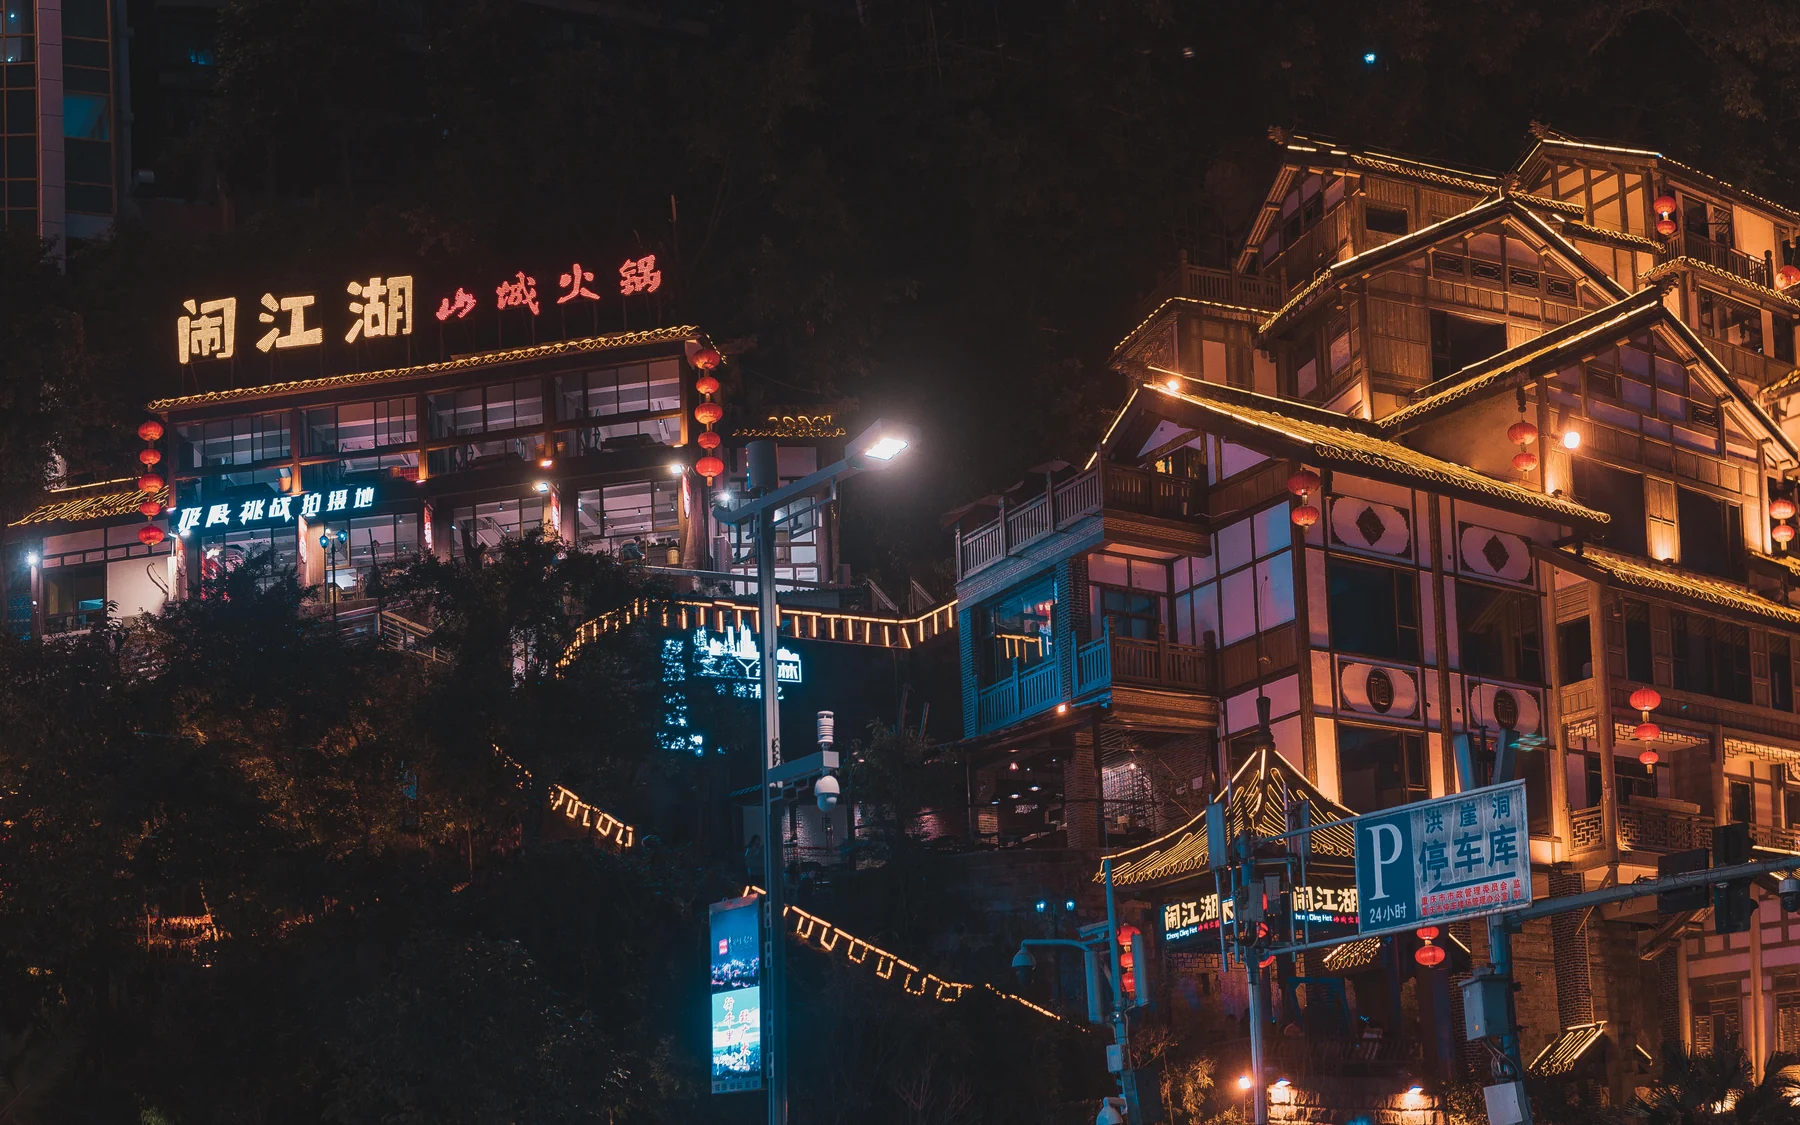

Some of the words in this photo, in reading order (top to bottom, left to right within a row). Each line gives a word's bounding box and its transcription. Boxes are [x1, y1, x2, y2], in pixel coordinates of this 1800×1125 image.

[178, 275, 413, 364] 闹江湖
[436, 254, 662, 321] 山城火锅
[177, 486, 375, 530] 极限挑战拍摄地
[1425, 794, 1511, 834] 洪崖洞
[1366, 823, 1403, 901] P
[1418, 824, 1519, 884] 停车库
[1164, 893, 1219, 931] 闹江湖
[1292, 886, 1358, 913] 闹江湖
[1369, 903, 1407, 924] 24小时
[1421, 881, 1508, 906] 重庆市市政管理委员会
